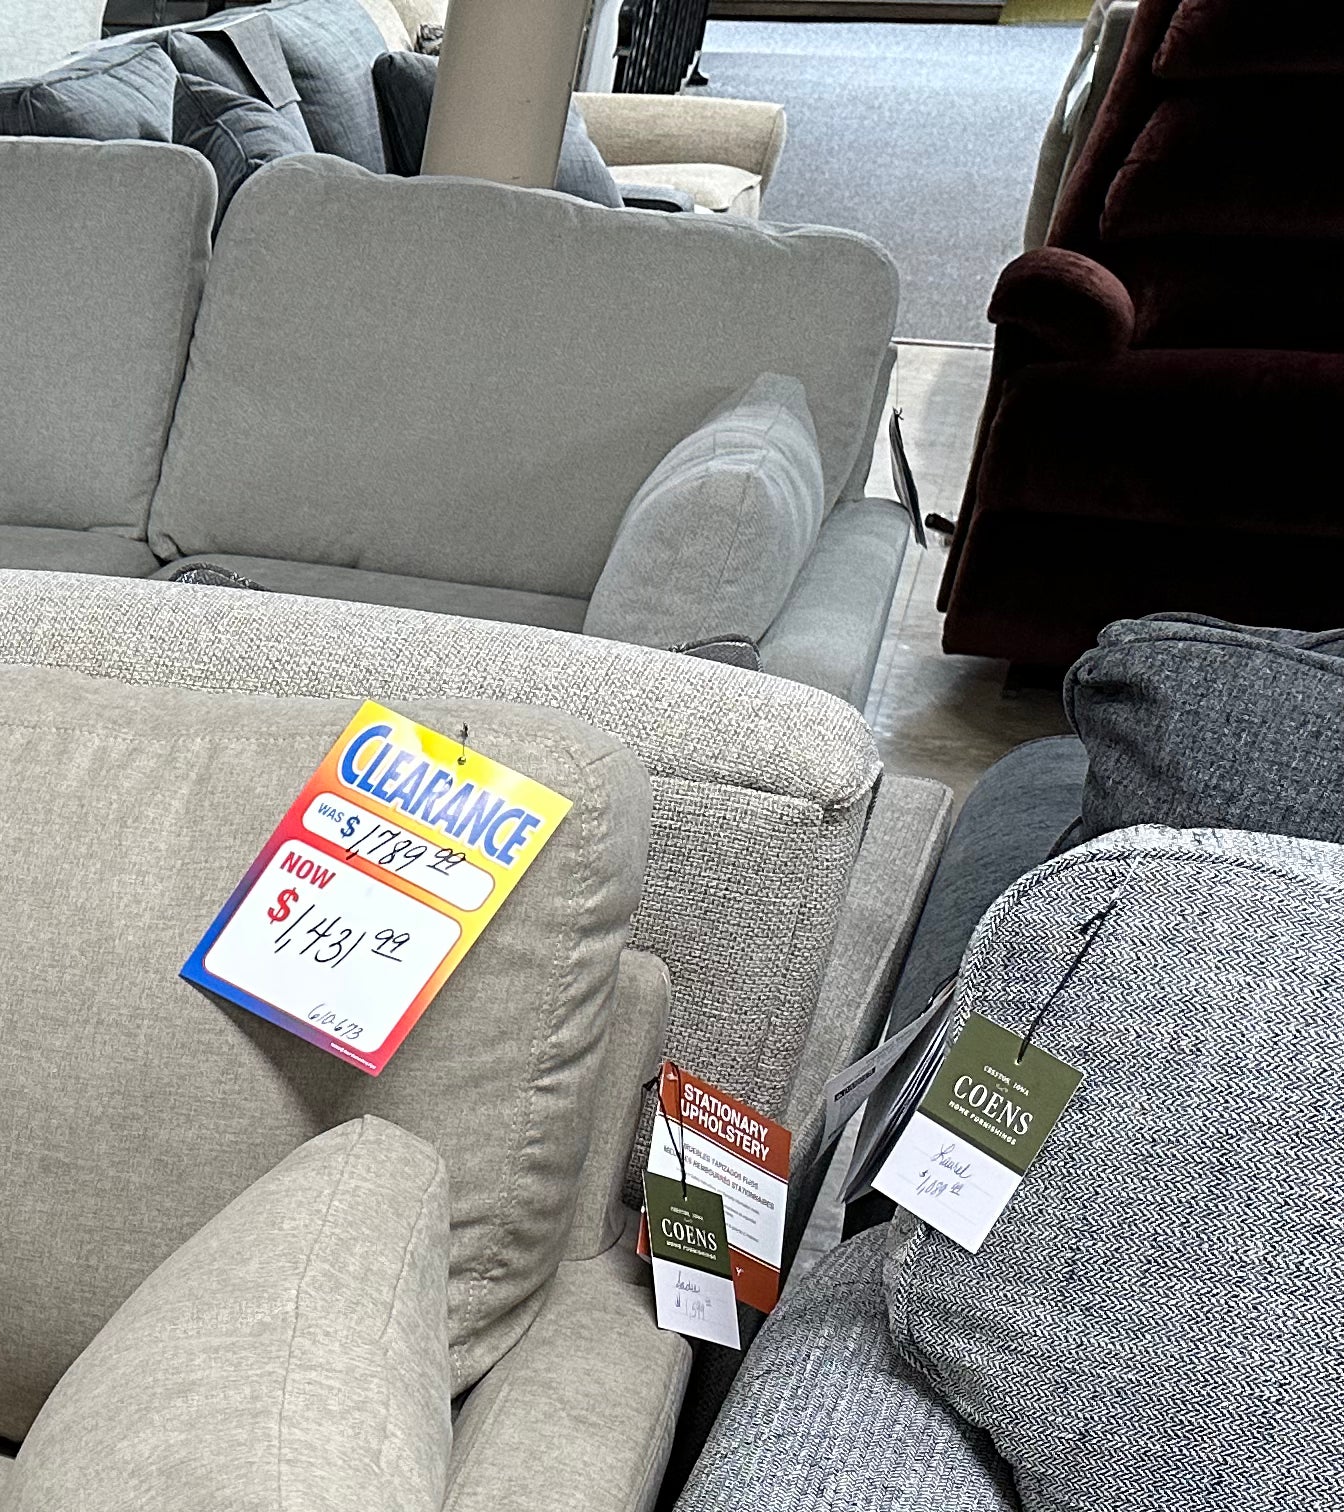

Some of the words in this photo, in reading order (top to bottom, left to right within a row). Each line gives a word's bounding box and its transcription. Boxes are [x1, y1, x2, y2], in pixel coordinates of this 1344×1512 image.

[318, 802, 344, 823] WAS
[340, 724, 542, 866] CLEARANCE
[280, 851, 336, 889] NOW
[683, 1084, 768, 1143] STATIONARY
[948, 1100, 970, 1118] HOME
[971, 1114, 1017, 1145] FURNISHINGS
[953, 1074, 1035, 1136] COENS
[680, 1101, 770, 1162] UPHOLSTERY
[661, 1218, 719, 1253] COENS
